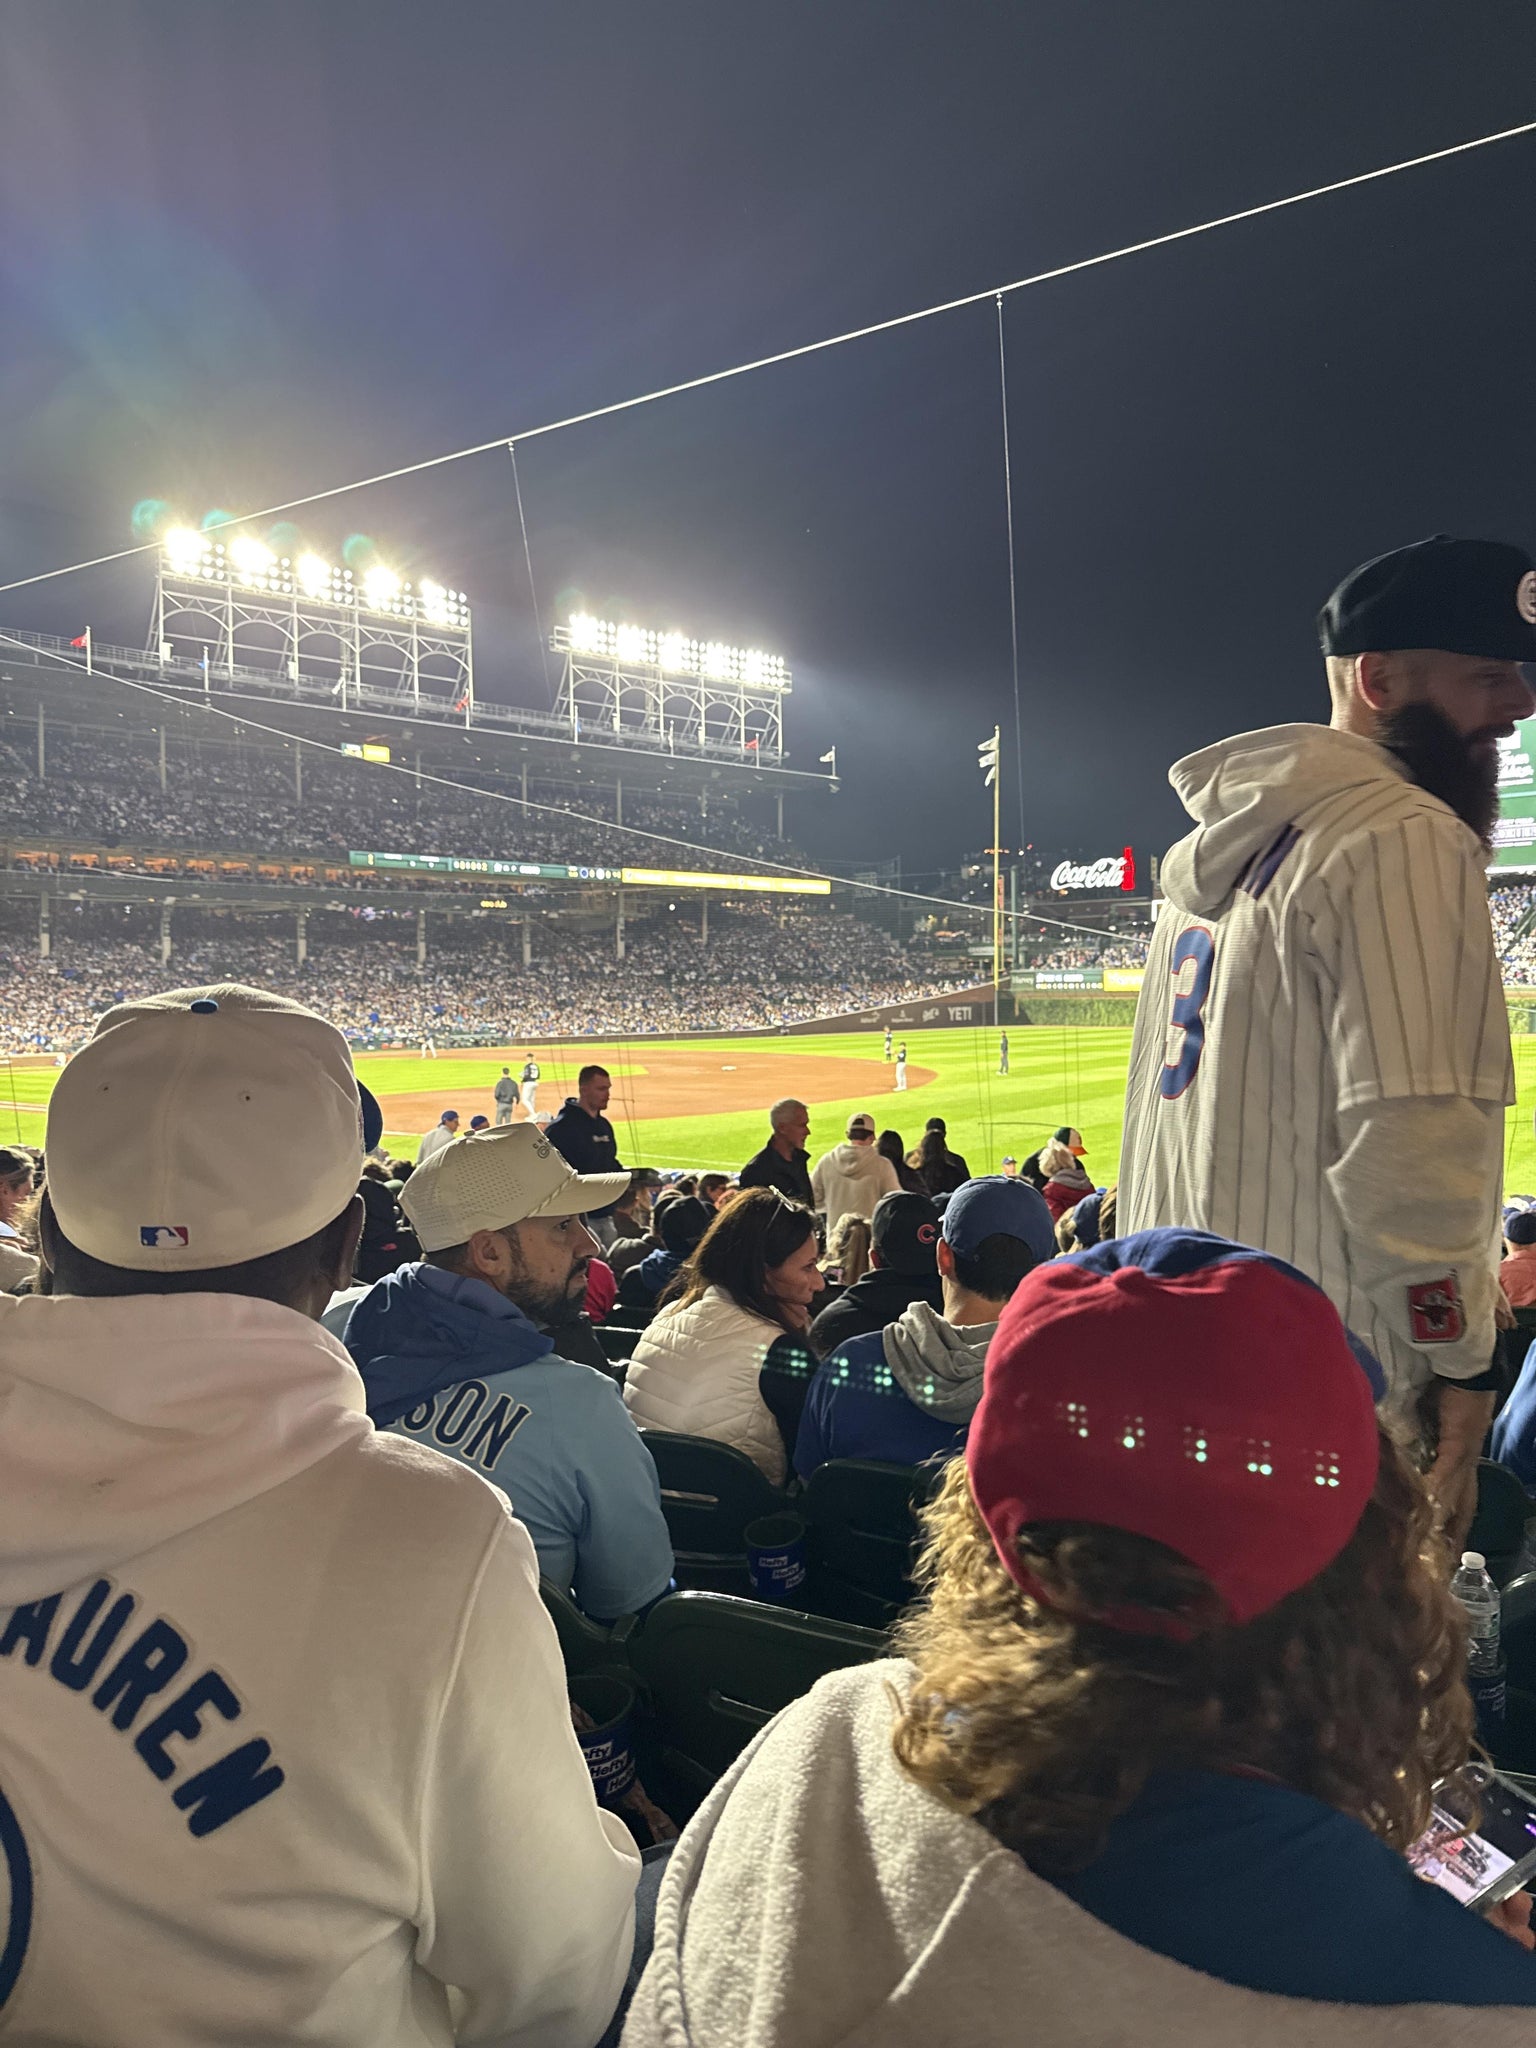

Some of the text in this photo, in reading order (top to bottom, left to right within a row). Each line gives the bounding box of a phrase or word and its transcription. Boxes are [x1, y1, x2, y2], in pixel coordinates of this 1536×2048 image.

[948, 1006, 972, 1021] YETI
[1161, 926, 1215, 1100] 3
[917, 1223, 936, 1244] C
[388, 1379, 532, 1471] SON
[590, 1754, 627, 1778] Hefty
